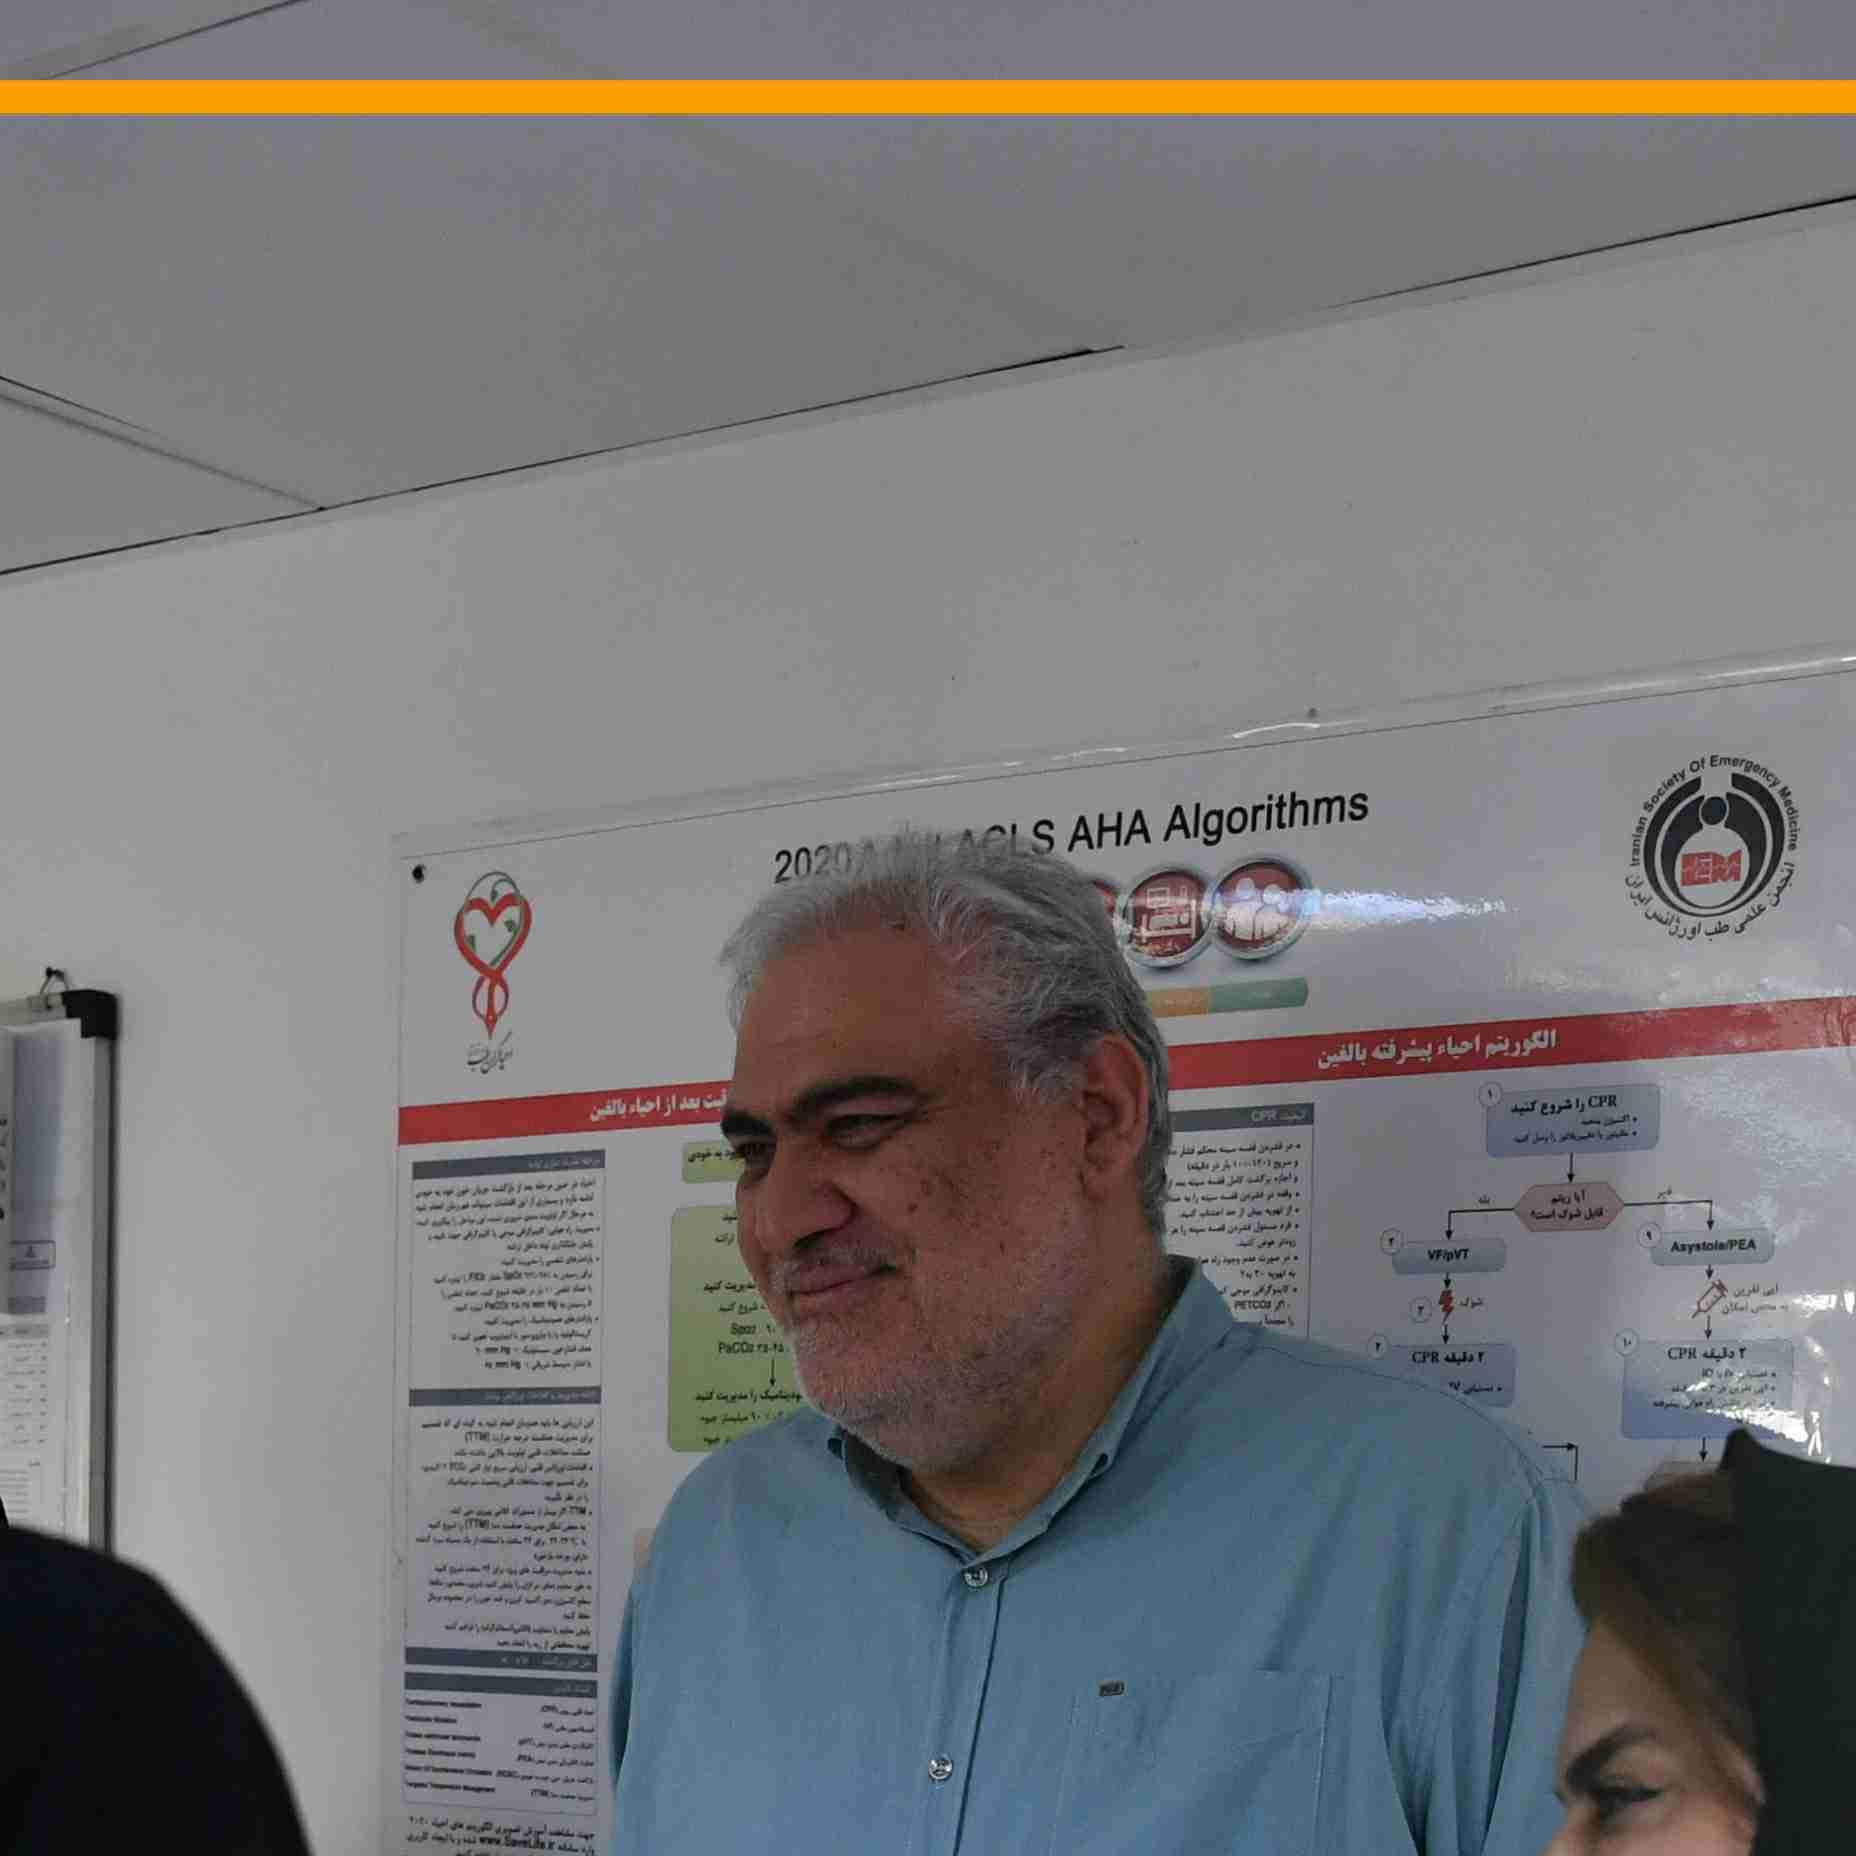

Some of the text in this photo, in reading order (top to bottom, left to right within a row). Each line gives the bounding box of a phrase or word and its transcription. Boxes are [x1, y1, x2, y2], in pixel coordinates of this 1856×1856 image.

[1067, 809, 1152, 853] AHA
[1163, 791, 1370, 848] Algorithms
[1629, 816, 1647, 867] Iranian
[1644, 768, 1687, 813] Society
[1709, 754, 1781, 788] Emergency
[1778, 786, 1801, 851] Medicine
[1371, 1039, 1433, 1065] پیشرفته
[1484, 1029, 1557, 1060] الگوریتم
[1317, 1043, 1368, 1070] بالغین
[590, 1098, 626, 1121] بالغین
[663, 1094, 677, 1116] از
[678, 1092, 701, 1112] بعد
[1587, 1094, 1617, 1108] CPR
[1411, 1351, 1440, 1363] CPR
[1667, 1347, 1697, 1360] CPR
